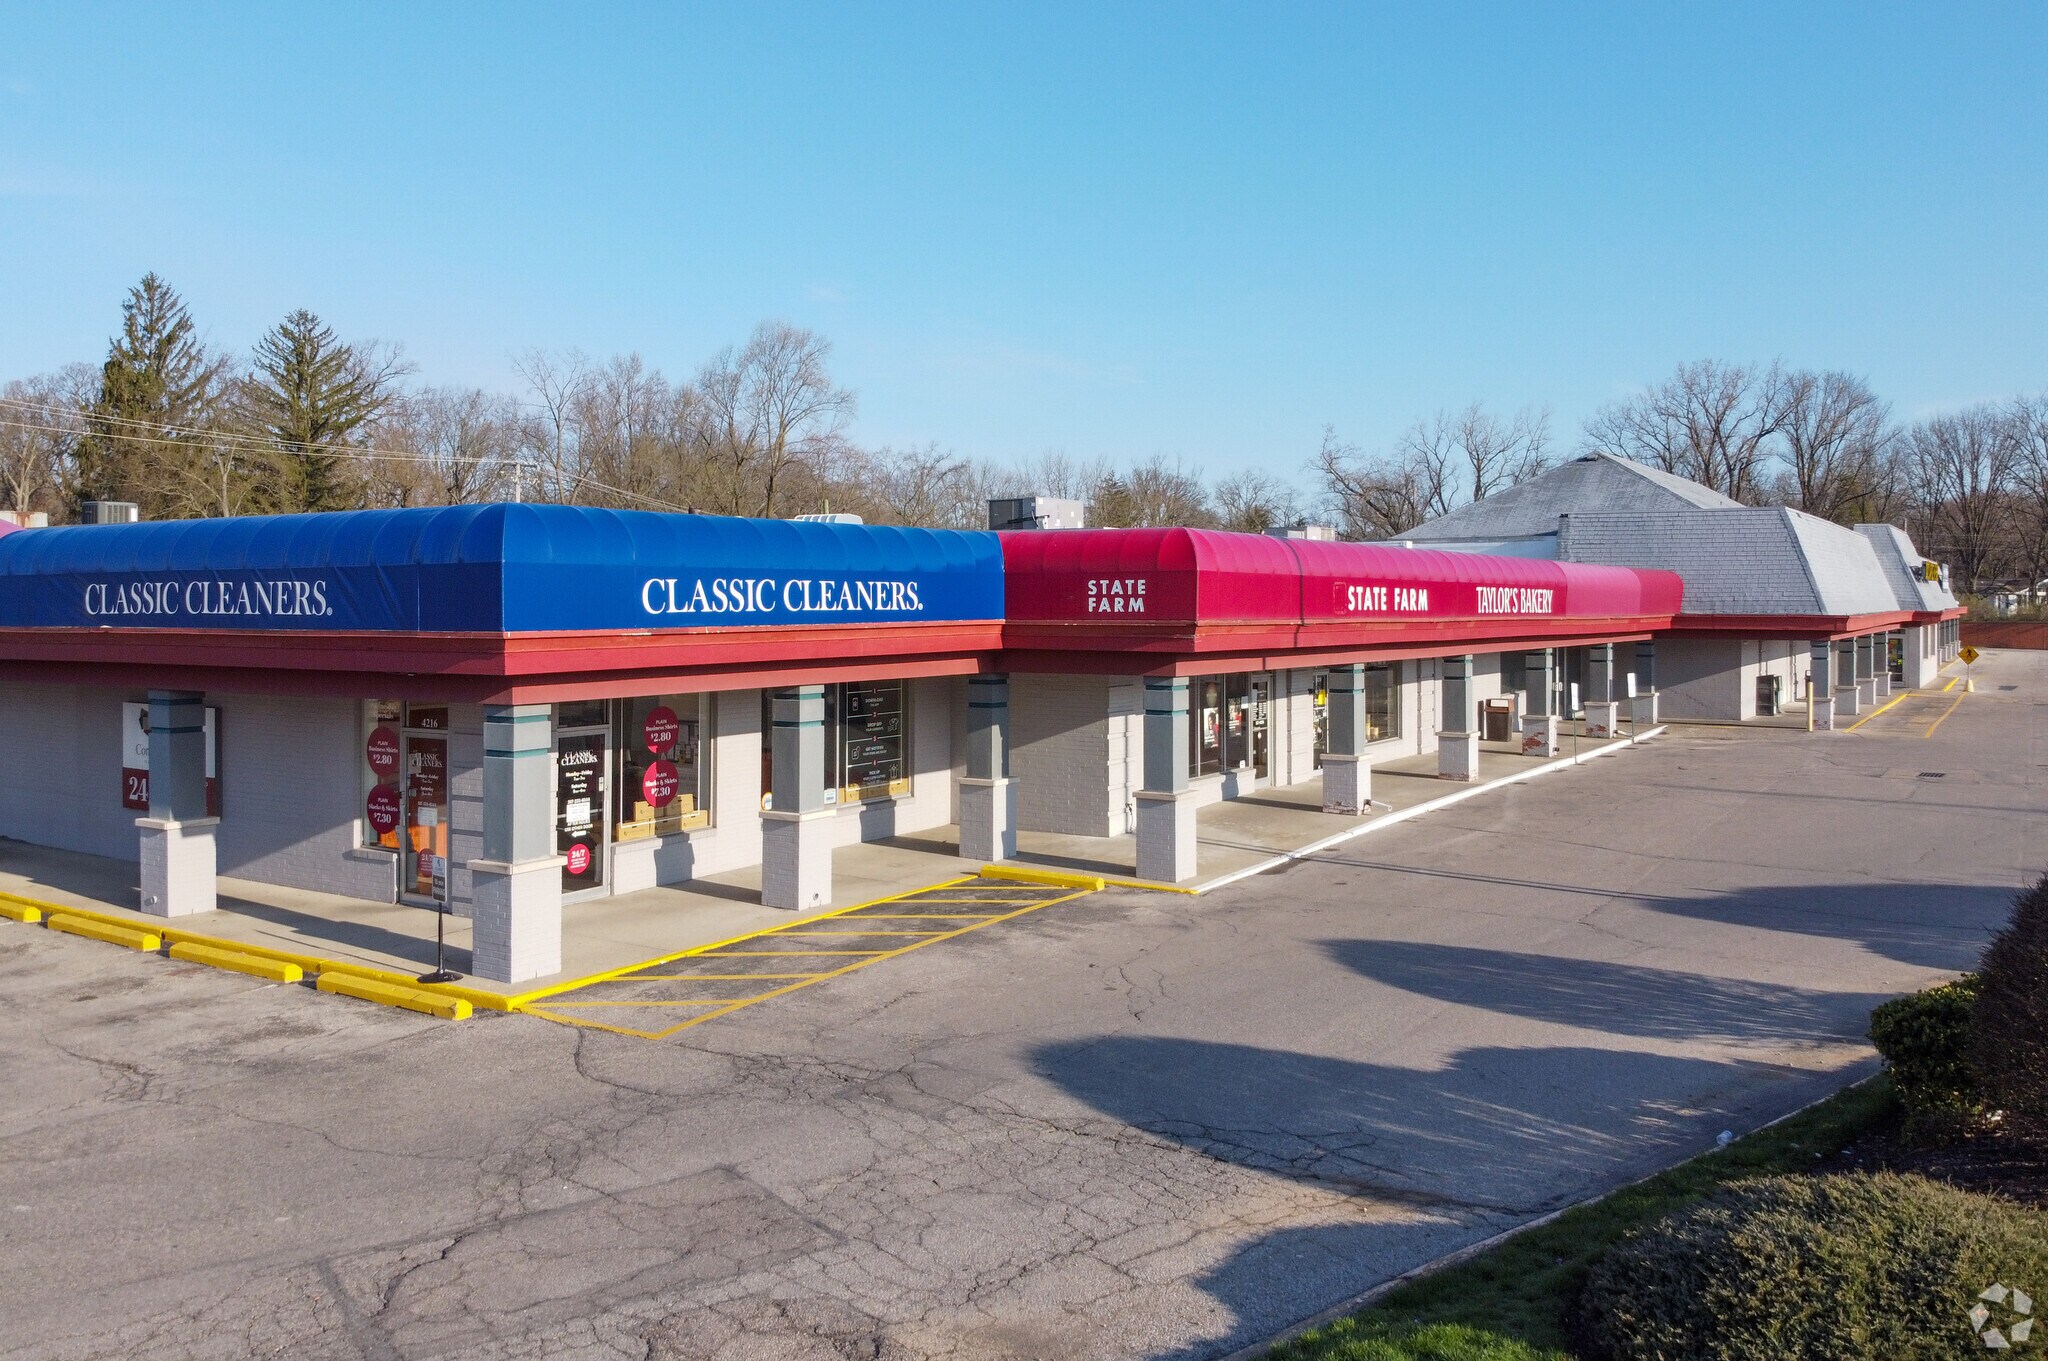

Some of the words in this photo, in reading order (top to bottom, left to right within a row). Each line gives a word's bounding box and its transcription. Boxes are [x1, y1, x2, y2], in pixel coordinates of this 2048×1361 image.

[1088, 580, 1146, 595] STATE
[85, 582, 179, 615] CLASSIC
[642, 578, 776, 614] CLASSIC
[1348, 586, 1387, 611] STATE
[1394, 587, 1429, 612] FARM
[1476, 586, 1519, 614] TAYLOR'S
[1520, 588, 1554, 614] BAKERY
[1088, 597, 1145, 612] FARM
[421, 718, 438, 728] 4216
[650, 731, 671, 742] $2.80
[373, 754, 392, 764] $2.80
[565, 749, 594, 759] CLASSIC
[651, 786, 670, 797] $7.30
[373, 813, 392, 823] $7.30
[571, 849, 585, 858] 24/7
